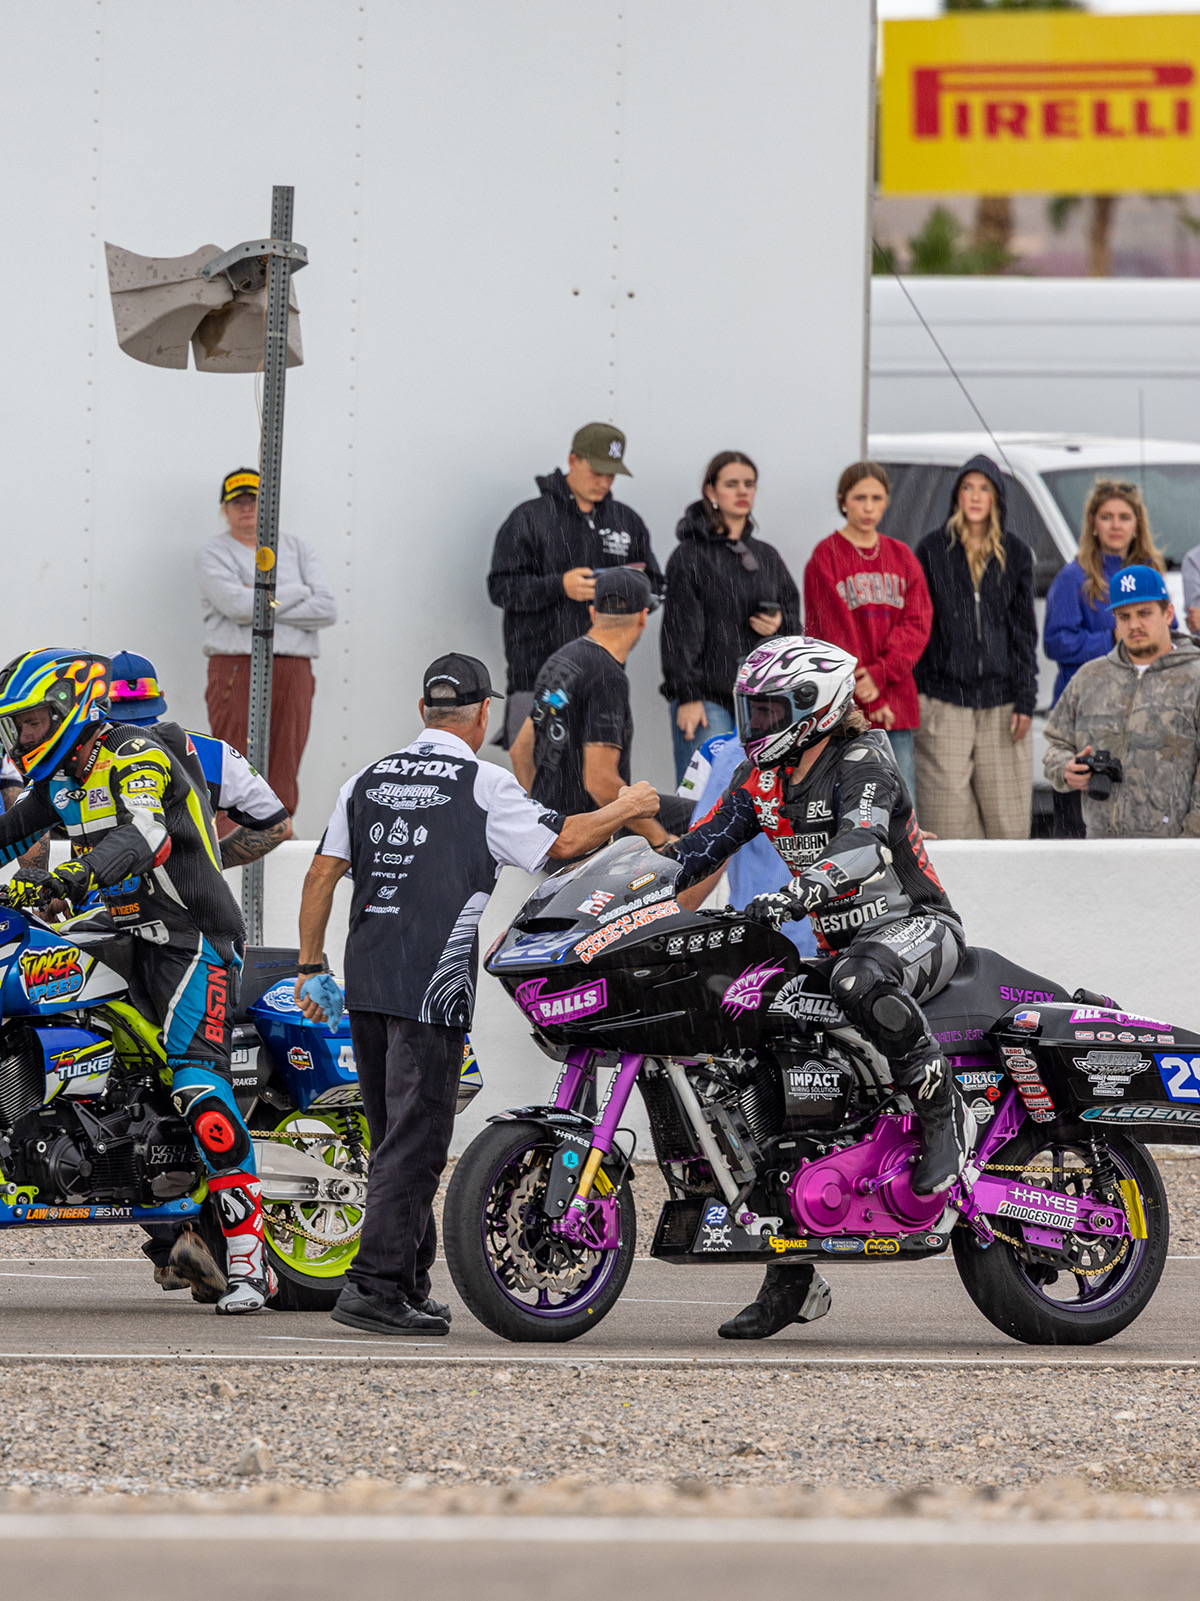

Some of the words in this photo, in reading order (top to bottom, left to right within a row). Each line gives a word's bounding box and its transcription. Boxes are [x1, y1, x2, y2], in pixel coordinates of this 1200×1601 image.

[912, 63, 1194, 141] PIRELLI
[821, 713, 838, 729] BELL
[373, 759, 464, 781] SLYFOX
[88, 789, 109, 805] BRL
[806, 800, 832, 818] BRL
[598, 898, 642, 923] BRENDAN
[641, 885, 674, 905] FOLEY
[574, 916, 632, 955] SUBURBAN
[580, 905, 681, 965] HARLEY-DAVIDSON
[21, 948, 83, 986] TUCKER
[28, 974, 82, 1004] SPEED
[1000, 985, 1055, 1003] SLYFOX
[205, 964, 228, 1044] BISON
[539, 989, 598, 1018] BALLS
[798, 998, 839, 1016] BALLS
[802, 1014, 838, 1024] RACING
[1074, 1009, 1101, 1020] ALL
[964, 1029, 984, 1040] SEATS
[232, 1076, 258, 1087] RAKES
[790, 1073, 840, 1087] IMPACT
[963, 1072, 996, 1085] DRAG
[554, 1129, 591, 1149] HAYES
[1007, 1187, 1078, 1213] HAYES
[26, 1208, 48, 1220] LAW
[58, 1207, 91, 1219] TIGERS
[706, 1206, 728, 1220] 29
[999, 1202, 1075, 1229] BRIDGESTONE
